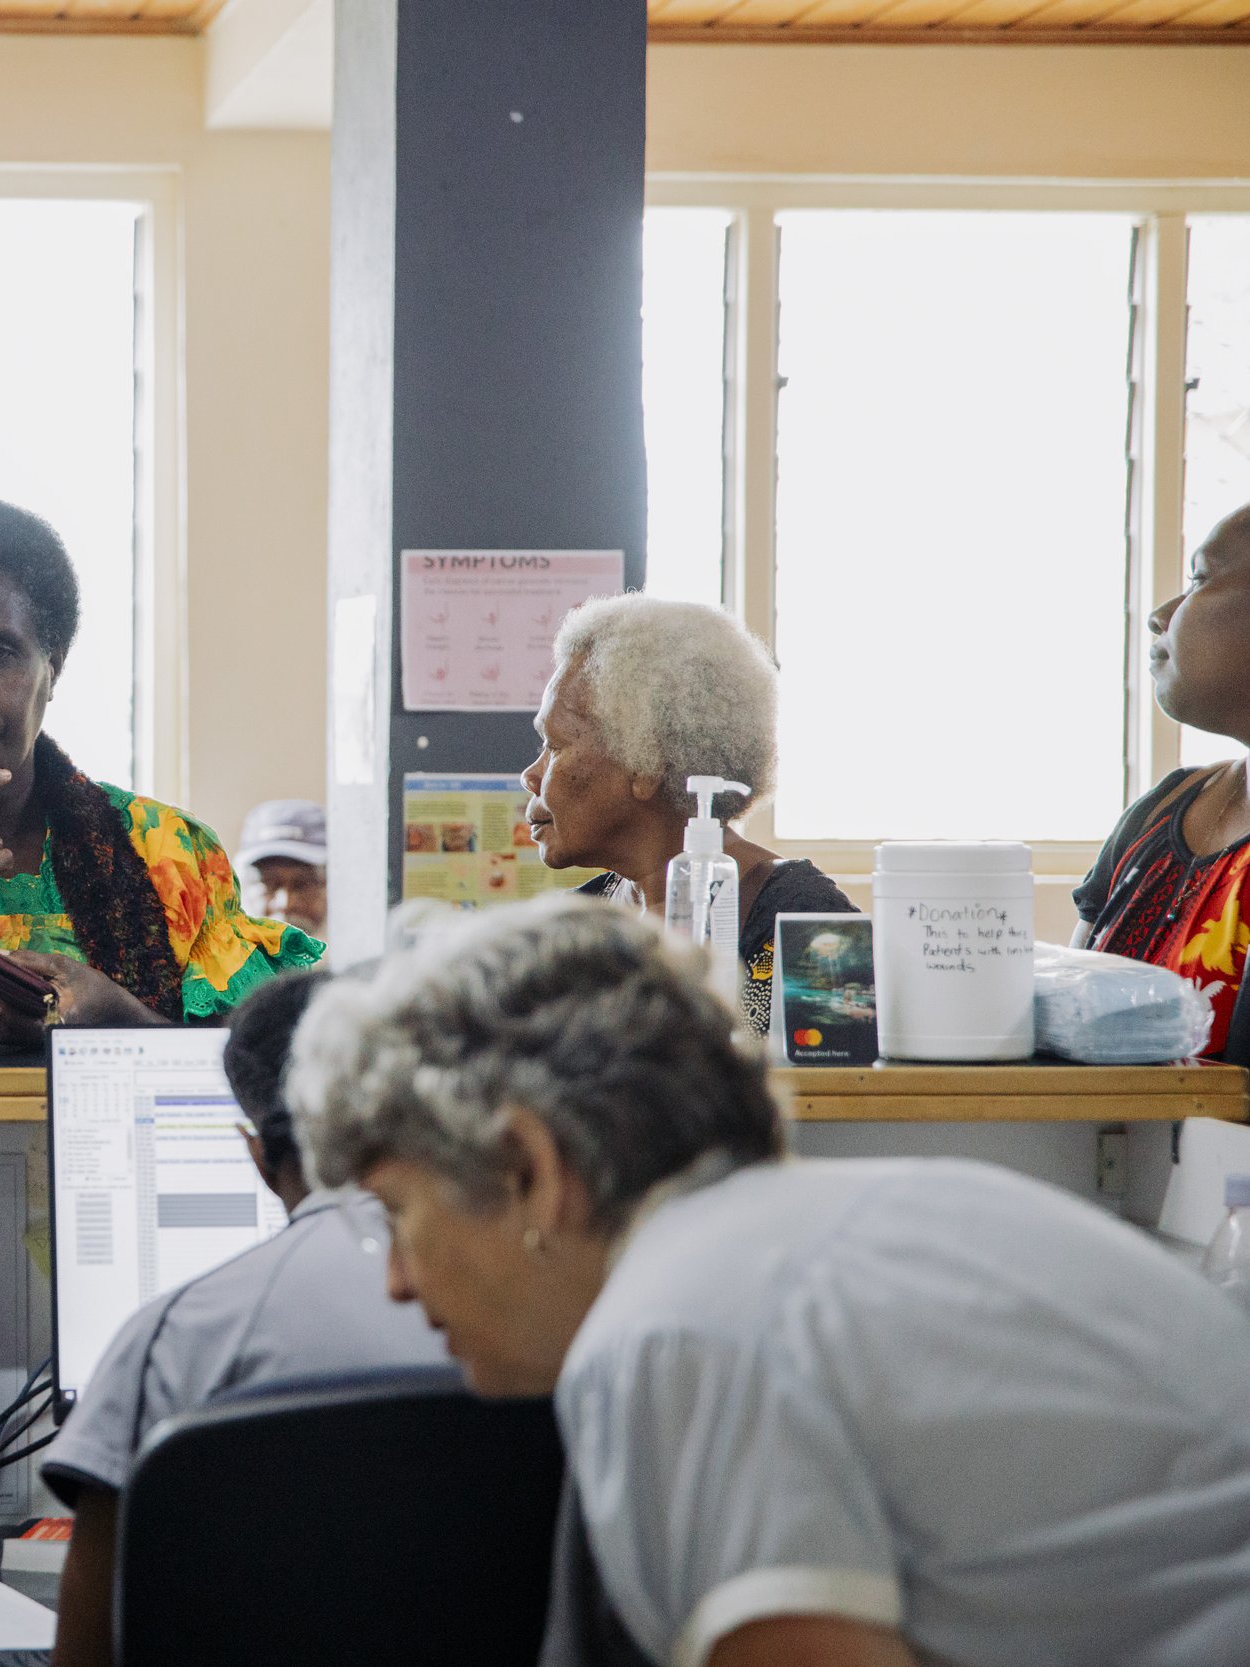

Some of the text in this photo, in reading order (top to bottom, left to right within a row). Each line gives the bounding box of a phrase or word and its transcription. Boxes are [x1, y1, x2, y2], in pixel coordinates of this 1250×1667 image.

[923, 925, 948, 939] This
[957, 929, 969, 938] to
[977, 927, 1003, 940] help
